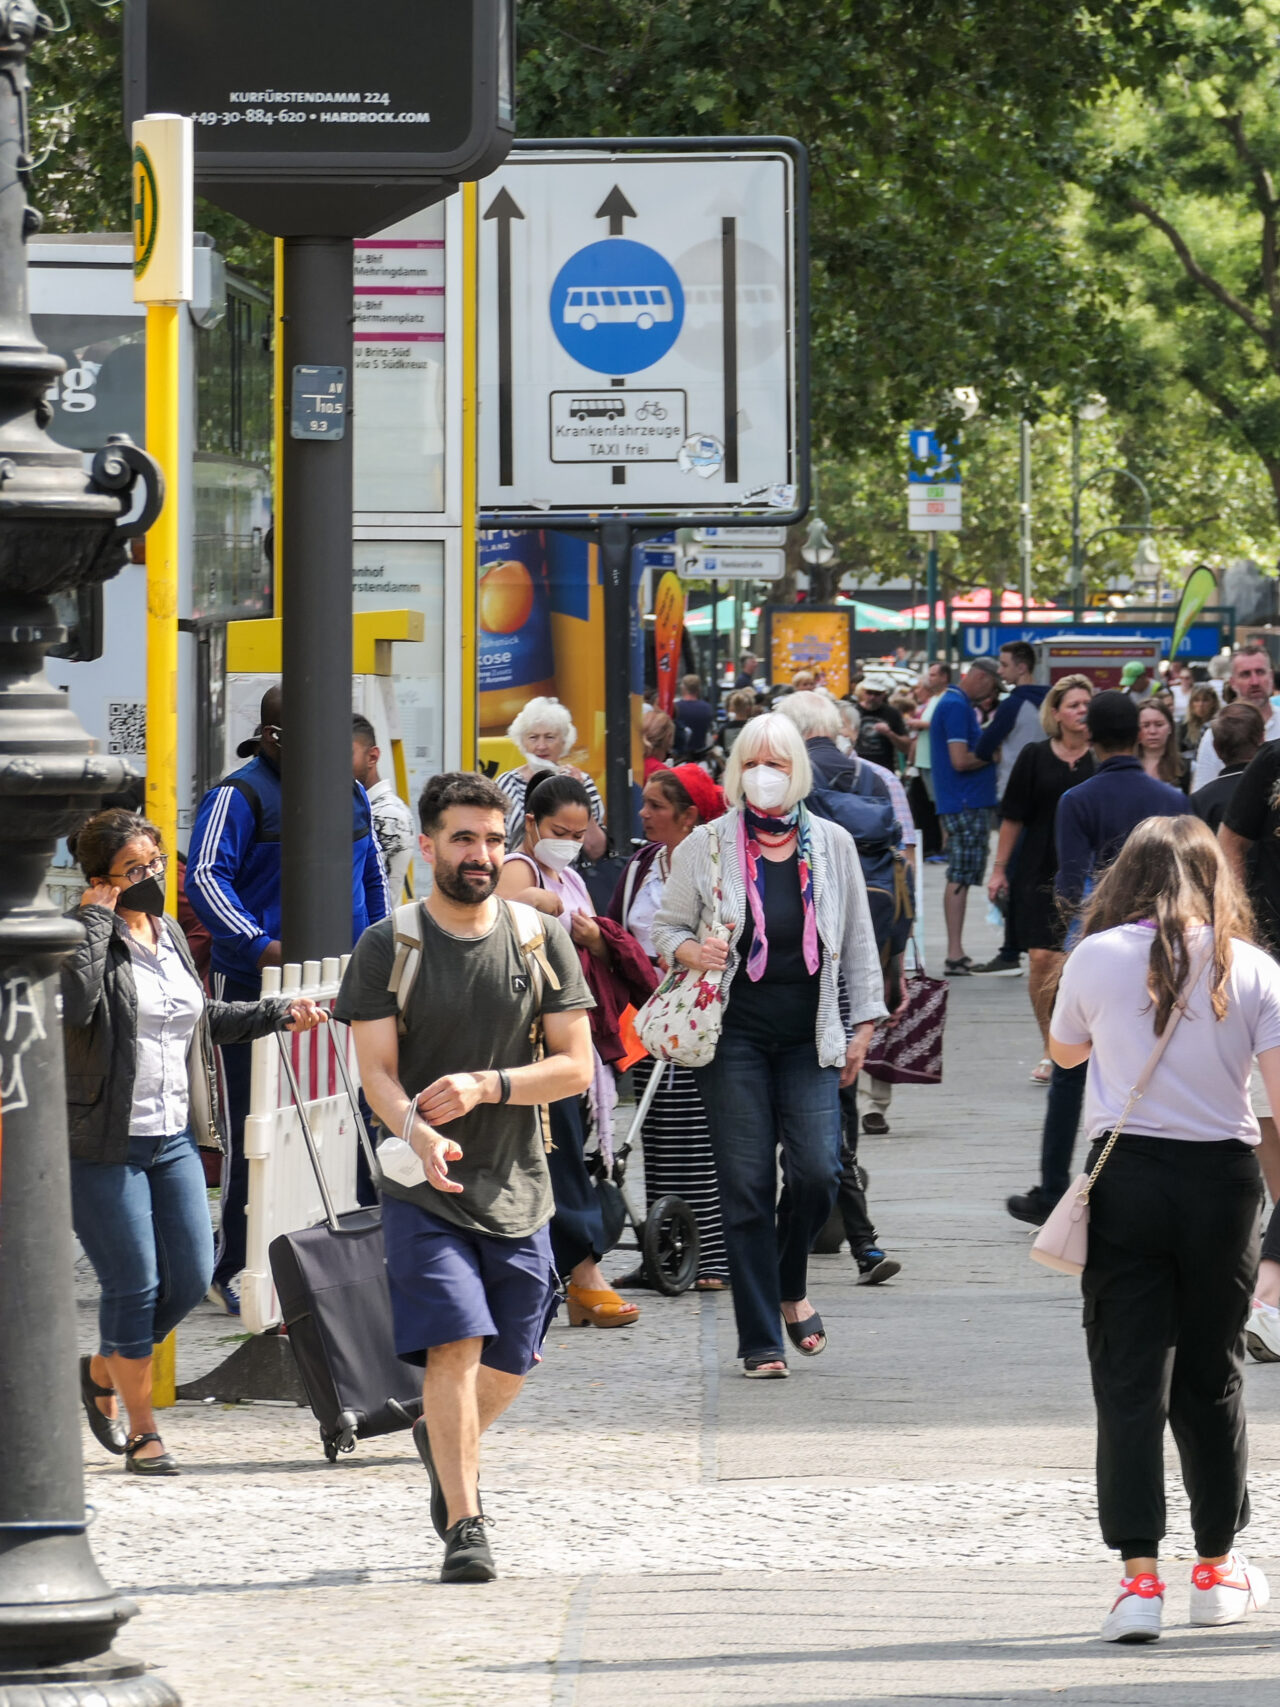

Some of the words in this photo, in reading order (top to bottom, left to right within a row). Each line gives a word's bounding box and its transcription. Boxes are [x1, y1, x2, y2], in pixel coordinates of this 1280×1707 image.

[229, 90, 360, 103] KURFÜRSTENDAMM
[364, 92, 390, 106] 224
[320, 111, 430, 123] HARDROCK.COM
[354, 267, 428, 279] Mehringdamm
[354, 313, 424, 324] Hermannplatz
[365, 347, 411, 357] Britz-Süd
[382, 359, 428, 369] Südkreuz
[556, 424, 681, 438] Krankenfahrzeuge
[590, 444, 619, 456] TAXI
[625, 443, 649, 456] frei
[967, 628, 990, 654] U
